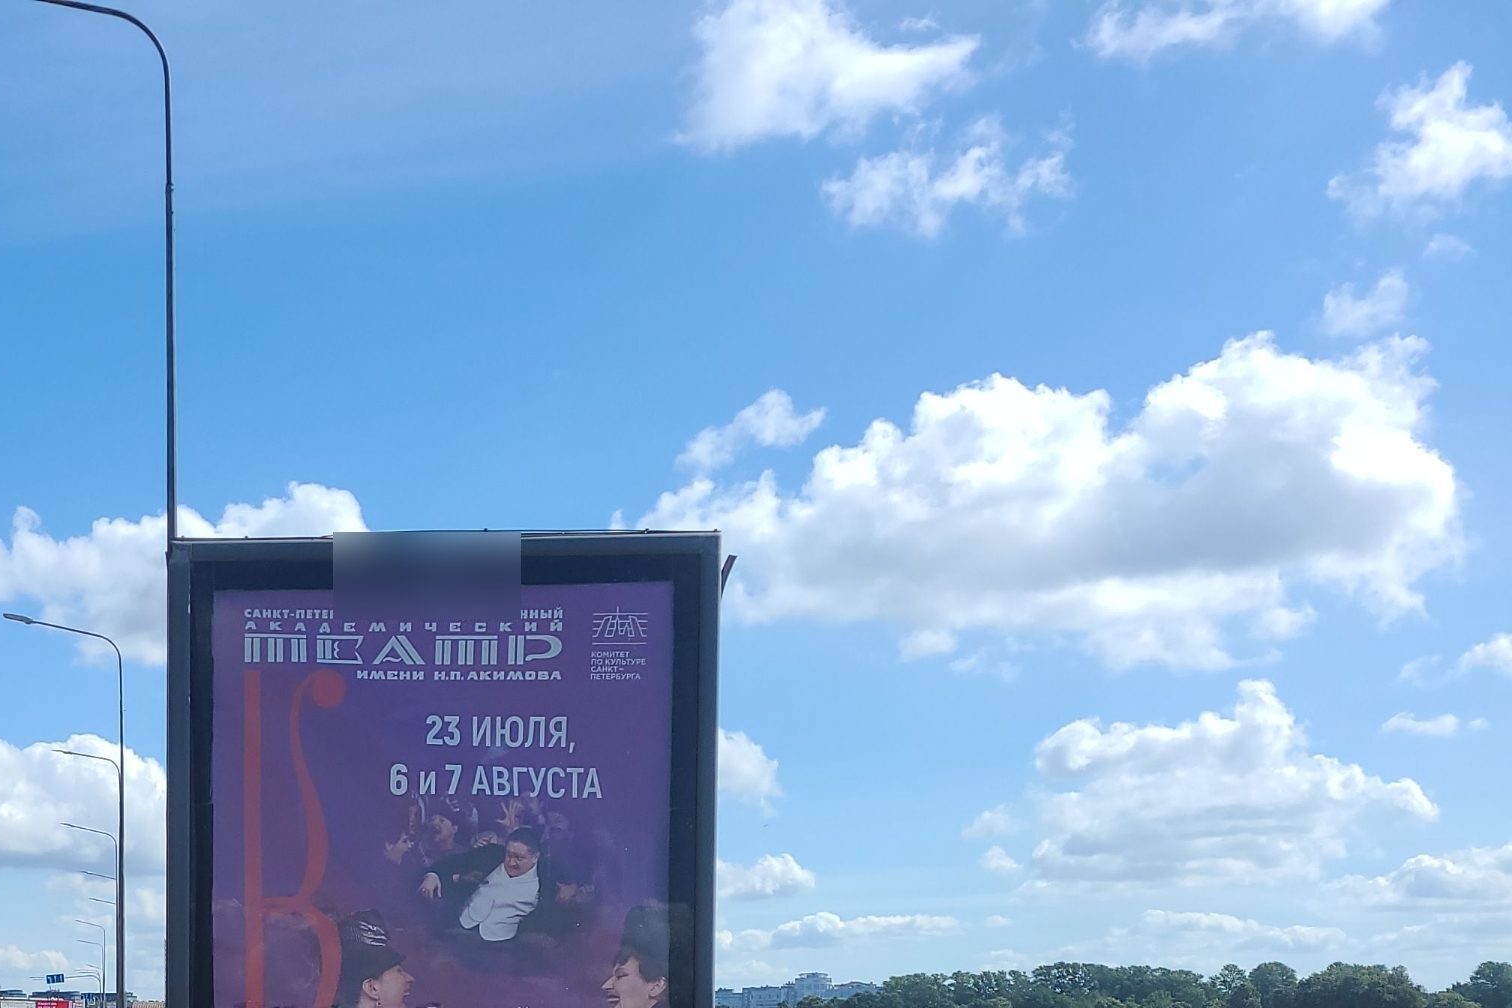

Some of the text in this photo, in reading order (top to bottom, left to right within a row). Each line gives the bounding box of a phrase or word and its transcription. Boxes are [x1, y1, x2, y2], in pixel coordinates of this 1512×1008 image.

[244, 609, 334, 619] САНКТ-ПЕТЕ
[245, 620, 563, 633] АКАДЕМИЧЕСКИЙ
[244, 633, 564, 665] ТЕАТР
[356, 670, 425, 681] ИМЕНИ
[425, 715, 575, 753] 23 ИЮЛЯ,
[390, 764, 408, 796] 6
[444, 764, 463, 796] 7
[471, 766, 603, 799] АВГУСТА
